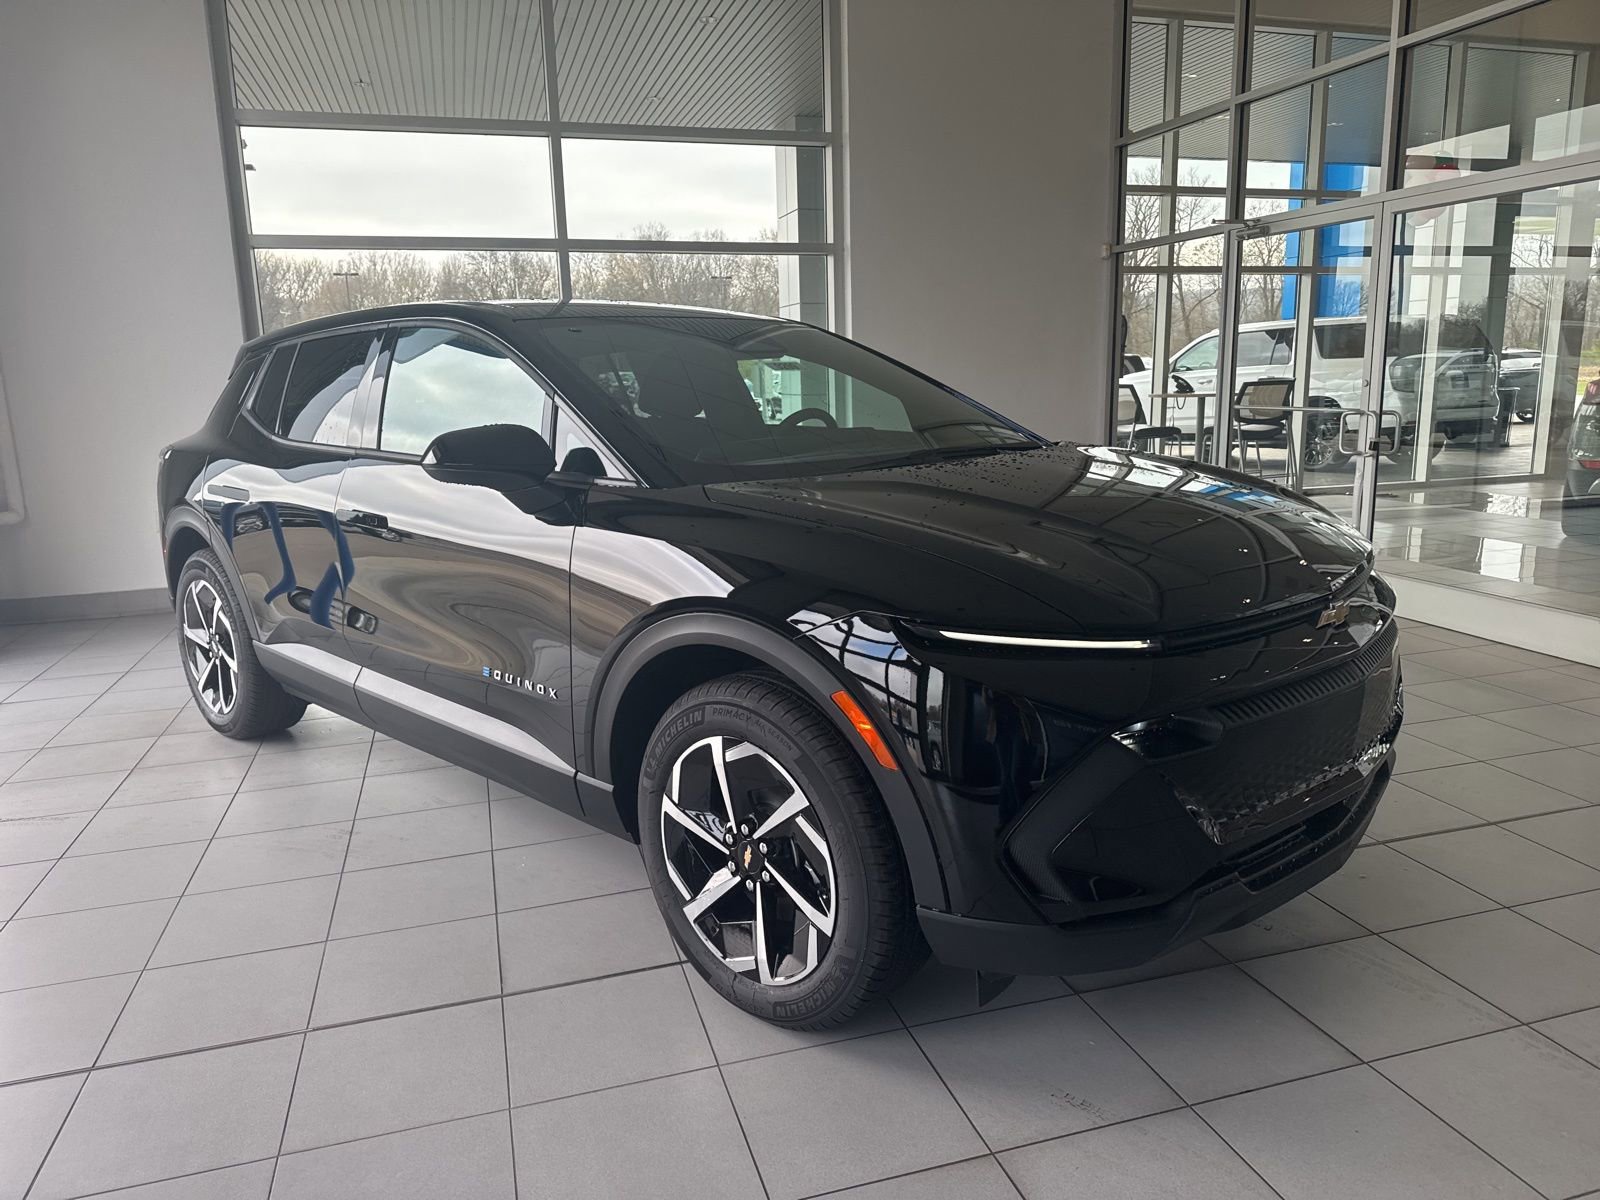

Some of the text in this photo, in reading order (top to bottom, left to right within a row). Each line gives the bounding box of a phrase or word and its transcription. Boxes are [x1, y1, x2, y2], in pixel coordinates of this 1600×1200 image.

[482, 666, 557, 699] EQUINOX
[712, 707, 752, 722] PRIMACY
[655, 710, 703, 759] MICHELIN
[776, 980, 837, 1017] MICHELIN
